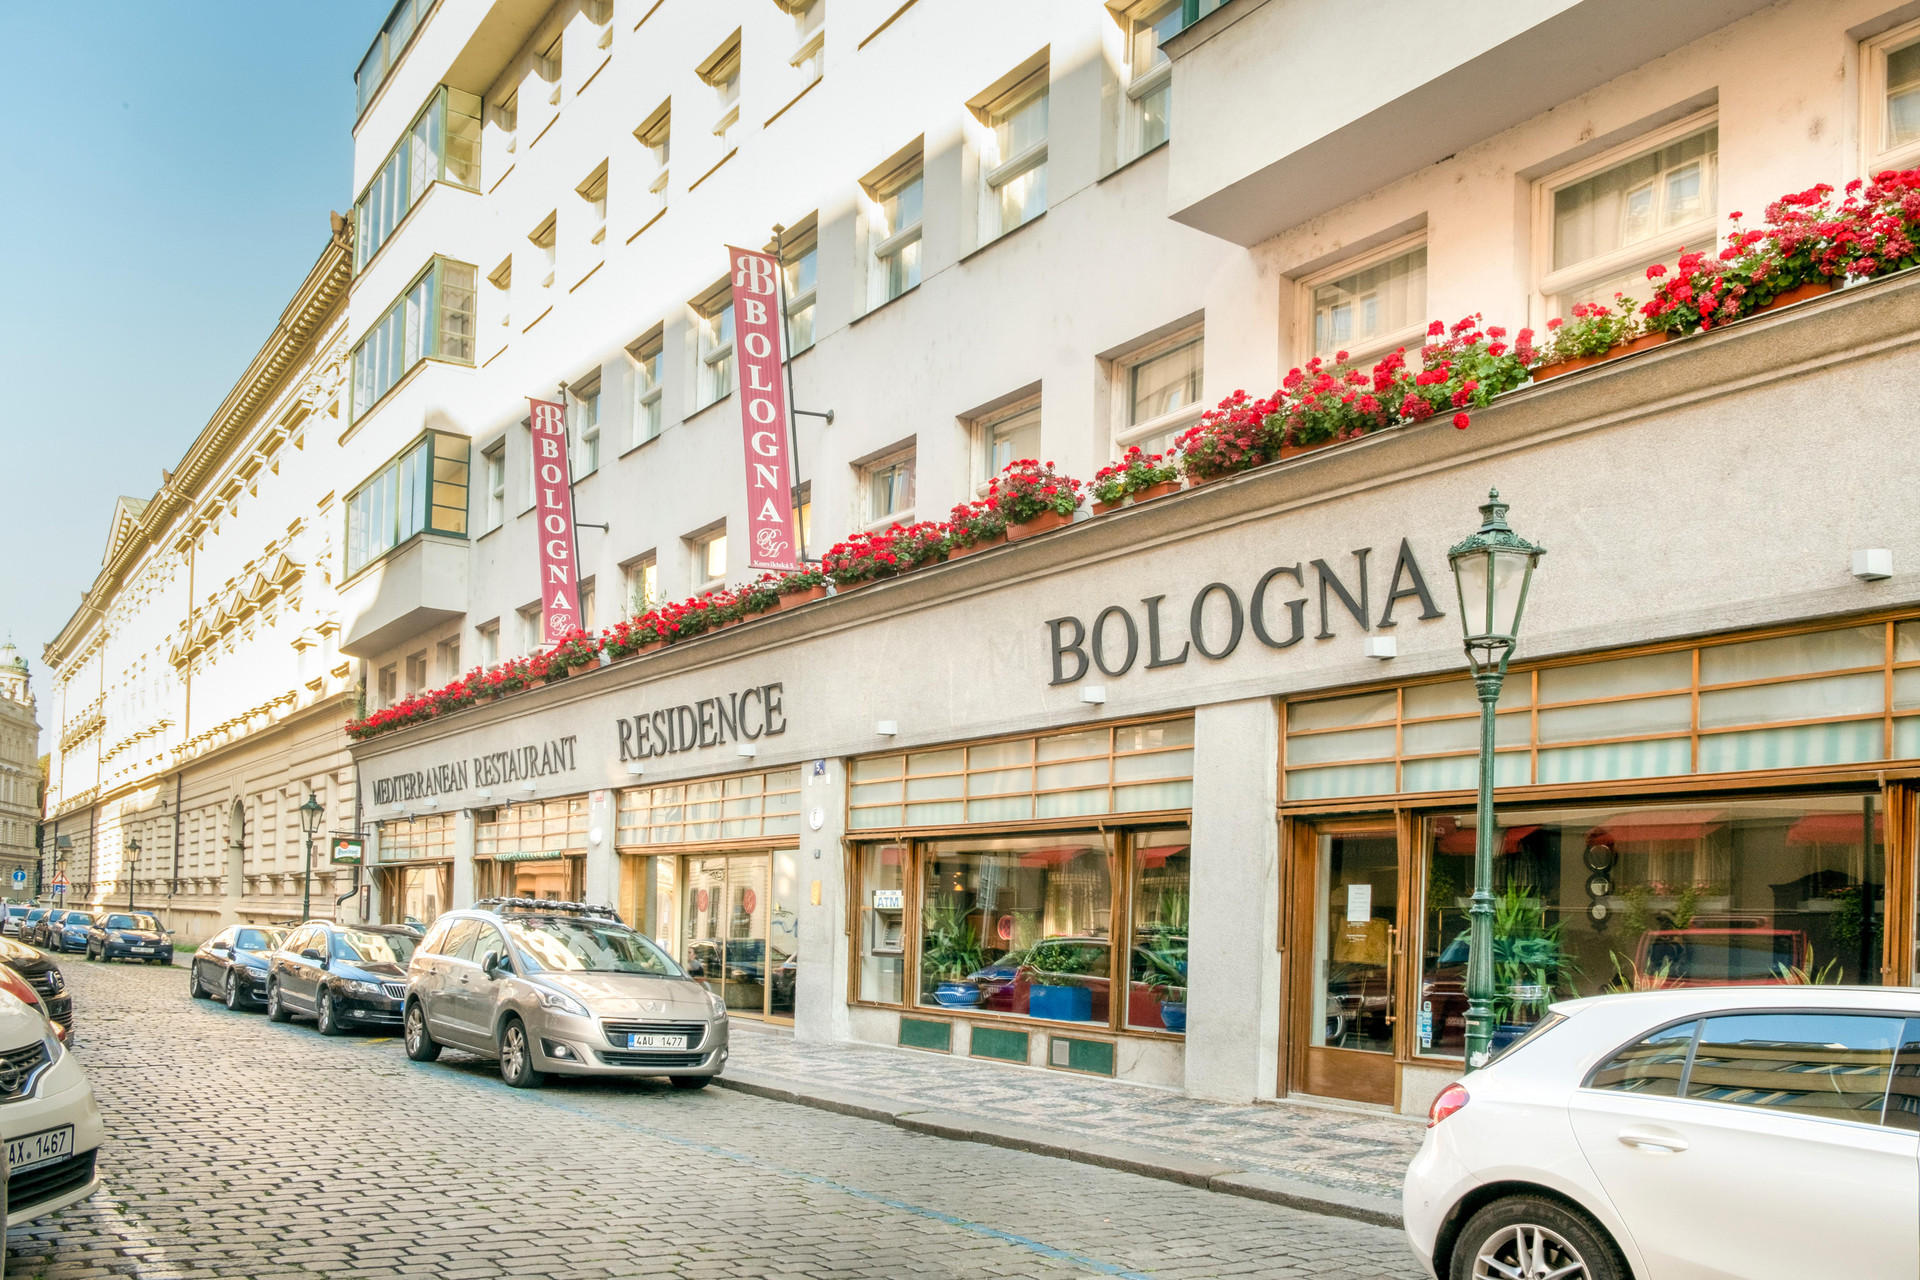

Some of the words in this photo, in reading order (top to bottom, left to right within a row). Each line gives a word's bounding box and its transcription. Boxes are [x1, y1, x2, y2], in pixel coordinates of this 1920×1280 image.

[742, 297, 784, 523] BOLOGNA
[540, 437, 573, 610] BOLOGNA
[1044, 536, 1446, 686] BOLOGNA
[616, 681, 787, 762] RESIDENCE
[371, 759, 469, 806] MEDITERRANEAN
[473, 735, 577, 788] RESTAURANT
[877, 896, 899, 908] ATM
[636, 1036, 654, 1046] 4AU
[661, 1037, 683, 1047] 1477
[8, 1141, 24, 1165] AX
[36, 1131, 66, 1158] 1467
